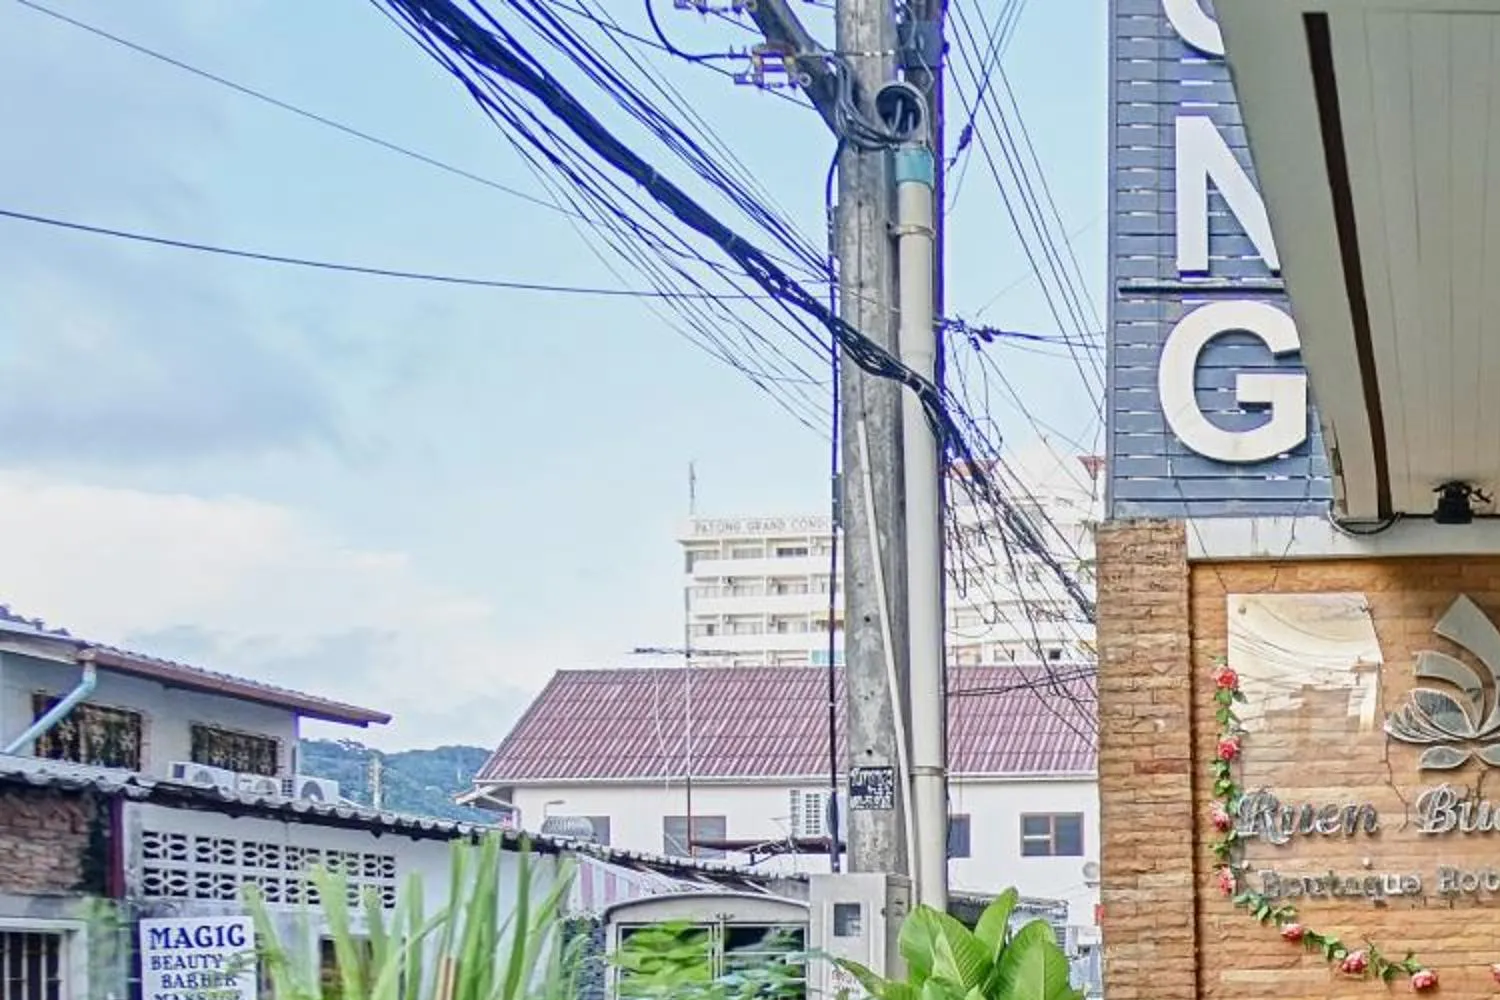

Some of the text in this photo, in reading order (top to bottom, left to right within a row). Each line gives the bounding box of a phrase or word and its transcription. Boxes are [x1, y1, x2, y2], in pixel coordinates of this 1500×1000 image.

[148, 924, 245, 950] MAGIC
[150, 953, 223, 971] BEAUTY
[161, 973, 237, 989] BARBER
